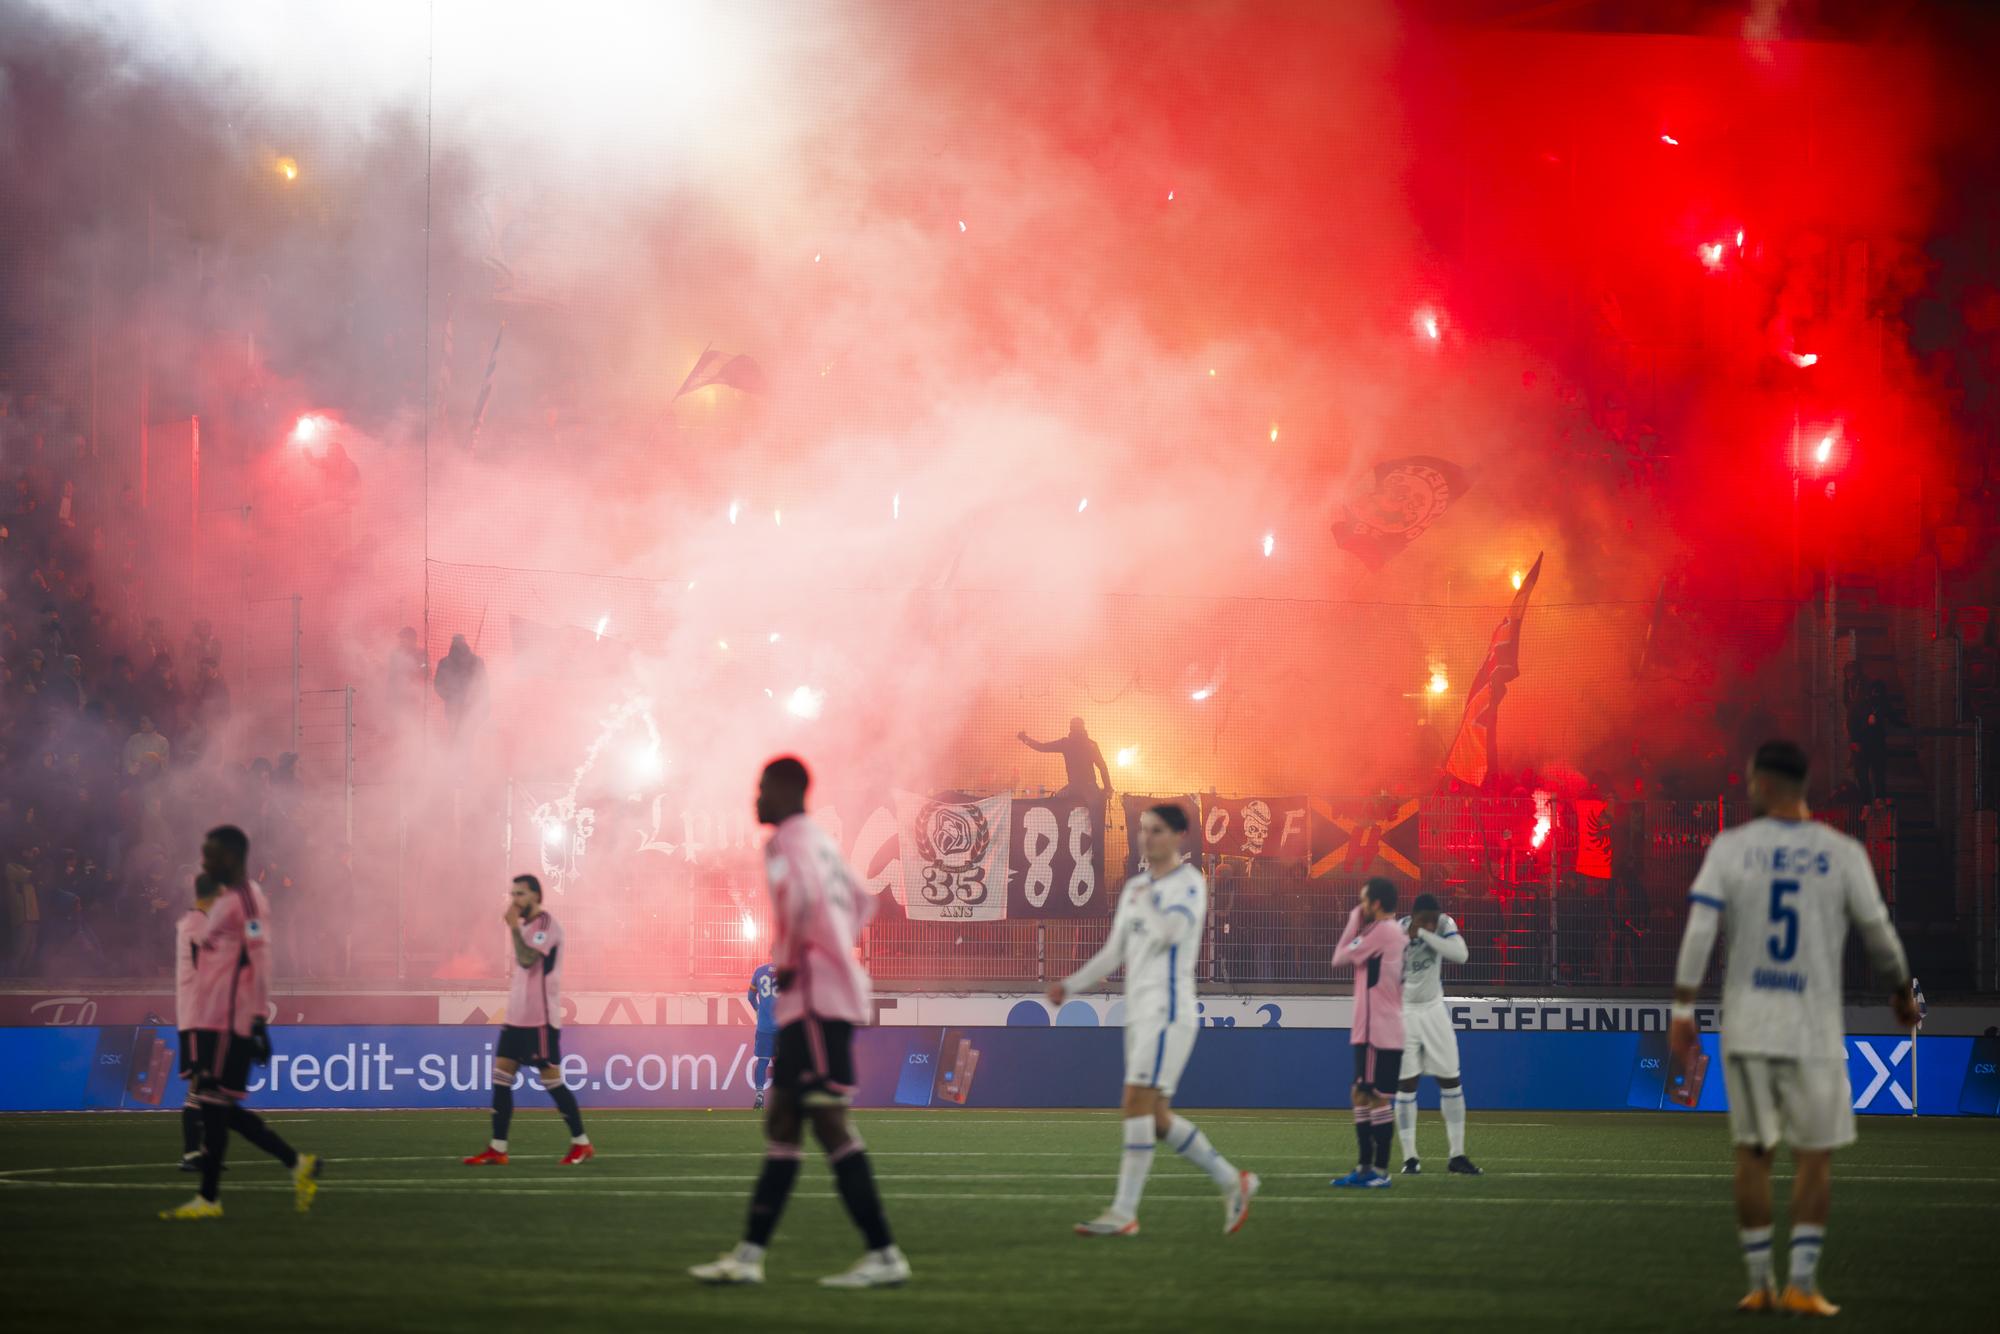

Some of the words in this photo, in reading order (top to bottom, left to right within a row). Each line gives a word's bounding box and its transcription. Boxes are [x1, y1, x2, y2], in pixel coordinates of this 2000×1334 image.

[921, 865, 988, 905] 35
[940, 905, 974, 918] ANS
[1766, 878, 1800, 964] 5
[909, 1053, 930, 1065] CSX
[1640, 1057, 1661, 1069] CSX
[1975, 1063, 1999, 1074] CSX
